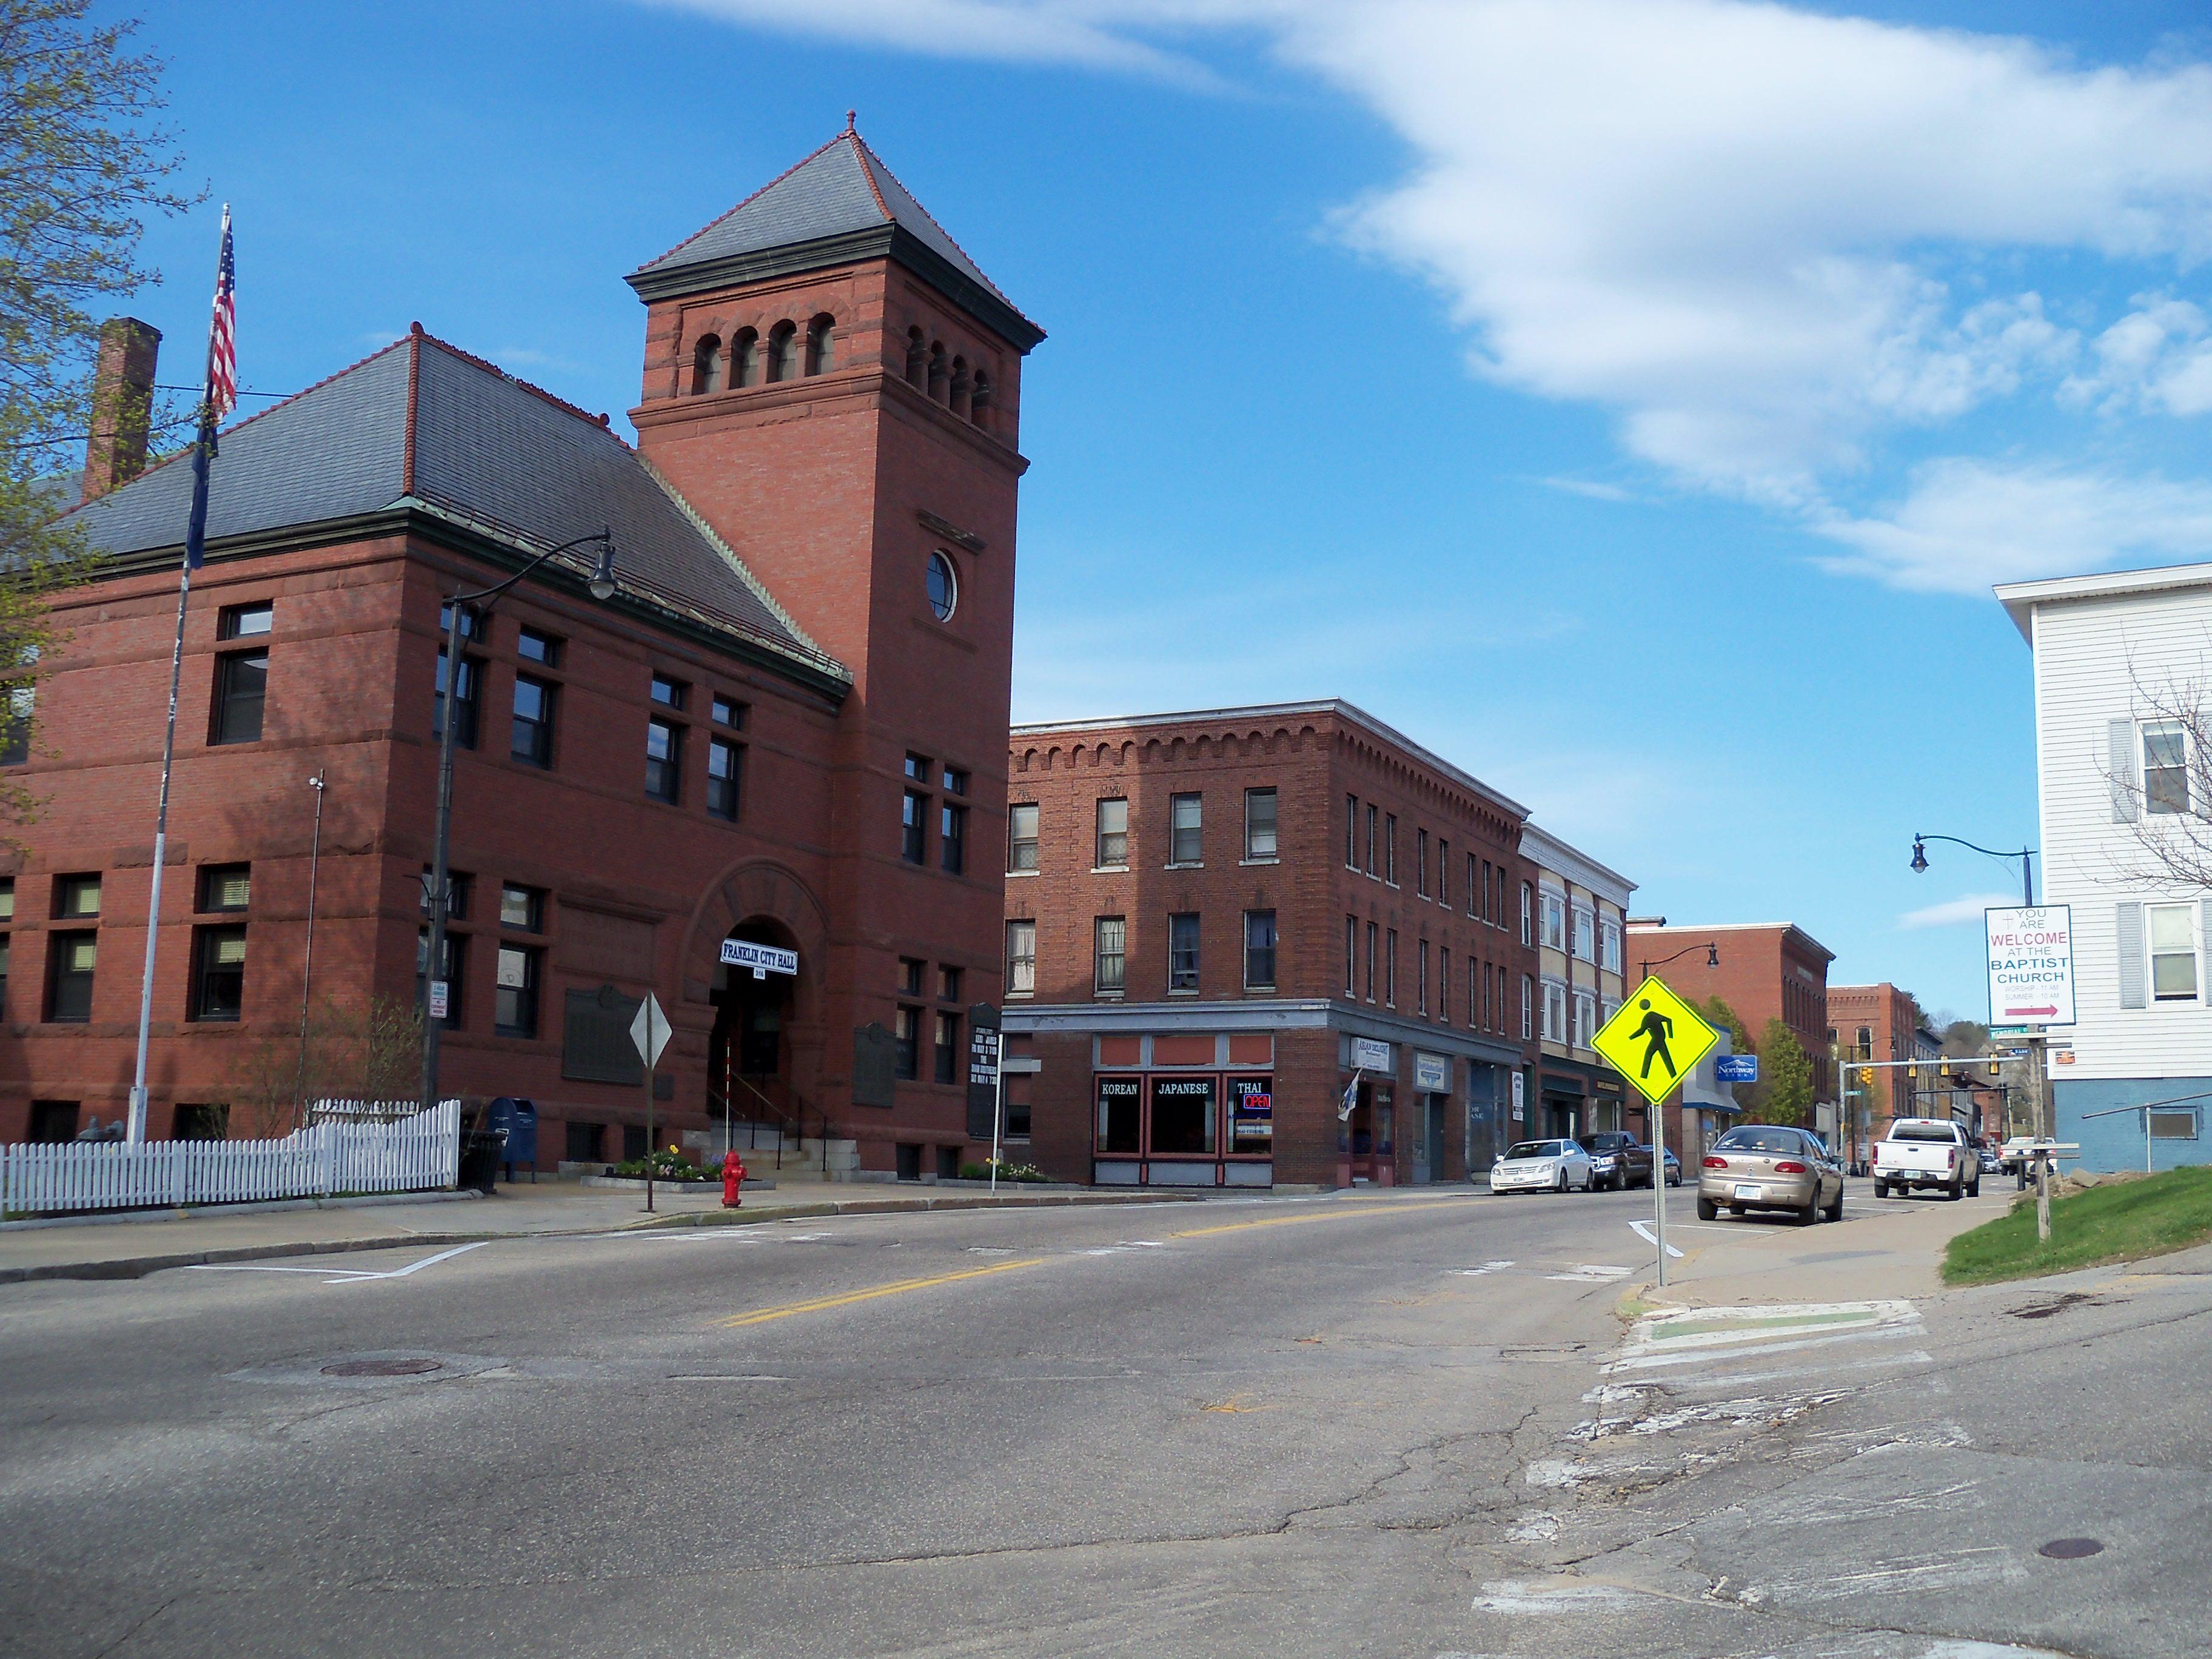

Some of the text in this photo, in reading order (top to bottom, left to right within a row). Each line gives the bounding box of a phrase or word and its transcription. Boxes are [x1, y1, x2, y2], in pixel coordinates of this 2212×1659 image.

[2016, 909, 2046, 918] YOU
[2019, 919, 2045, 929] ARE
[1991, 932, 2067, 947] WELCOME
[723, 943, 795, 969] FRANKLIN CITY HALL
[2007, 947, 2052, 956] AT THE
[1991, 957, 2069, 970] BAPTIST
[1997, 971, 2064, 984] CHURCH
[1718, 1065, 1755, 1075] Northway
[1102, 1084, 1138, 1094] KOREAN
[1158, 1083, 1208, 1094] JAPANESE
[1237, 1082, 1262, 1094] THAI
[1245, 1095, 1270, 1108] OPEN
